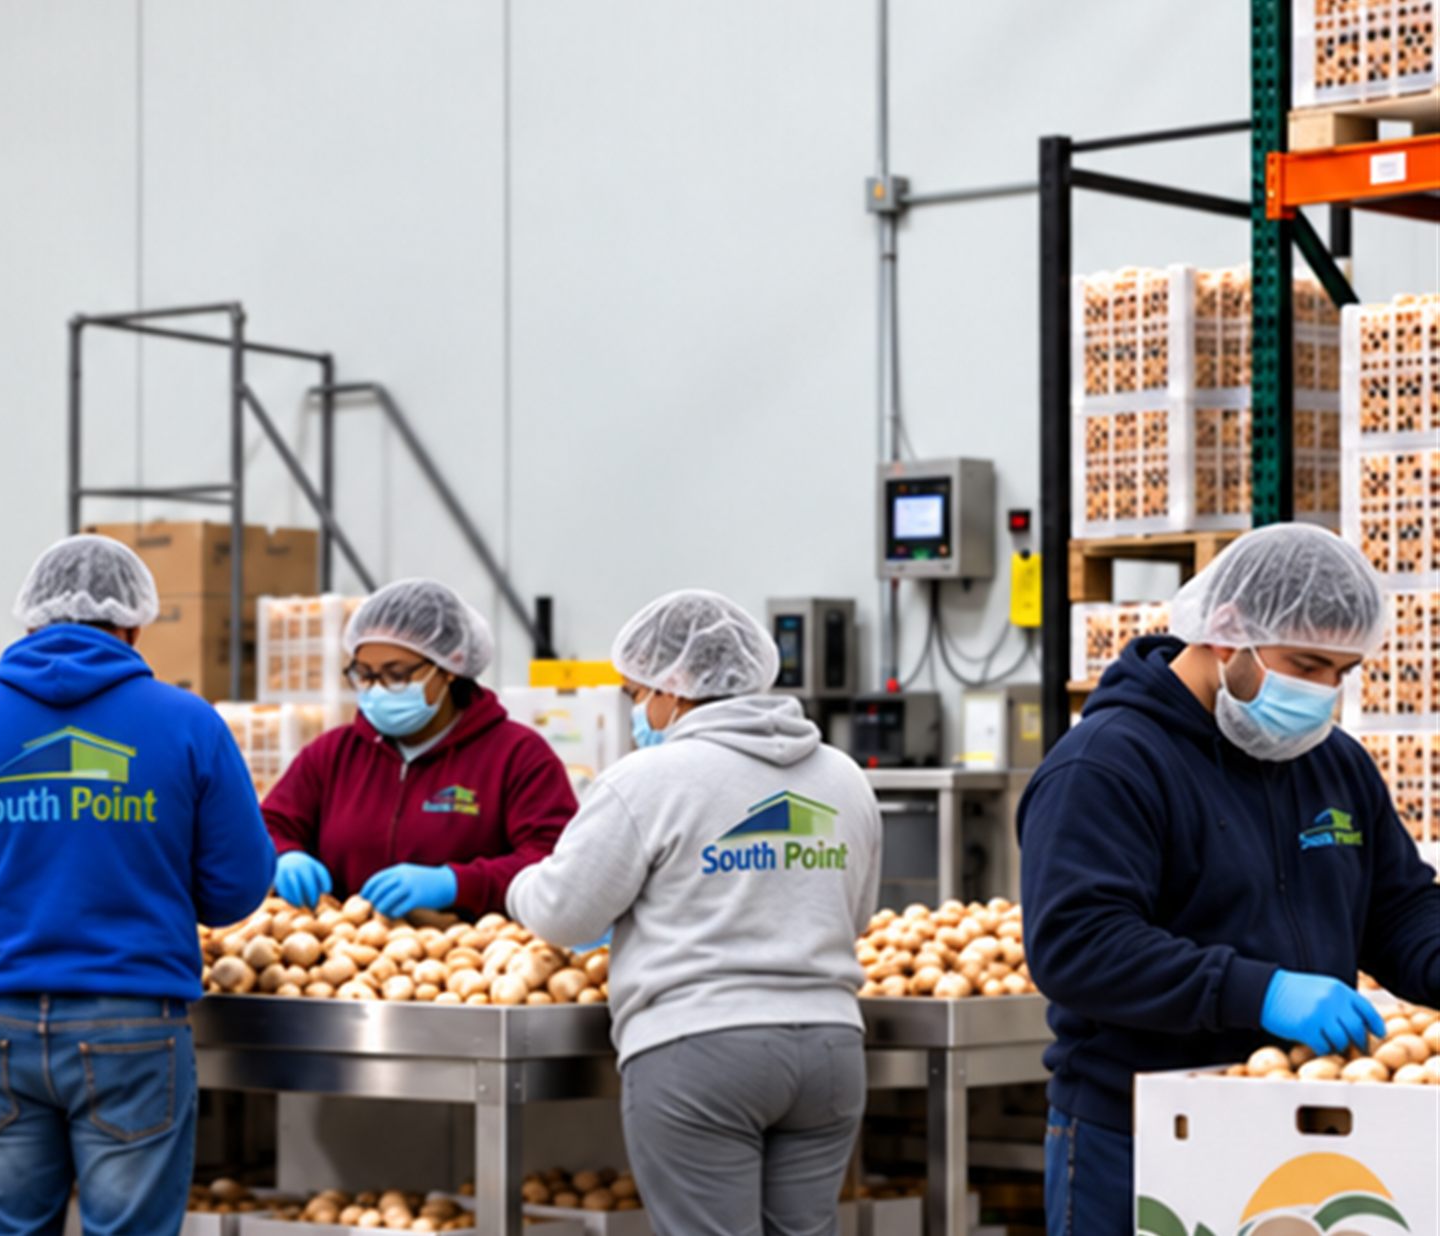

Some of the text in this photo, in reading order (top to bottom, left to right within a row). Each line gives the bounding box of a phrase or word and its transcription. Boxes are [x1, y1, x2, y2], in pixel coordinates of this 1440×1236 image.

[72, 786, 157, 822] Point
[702, 840, 848, 874] South Point
